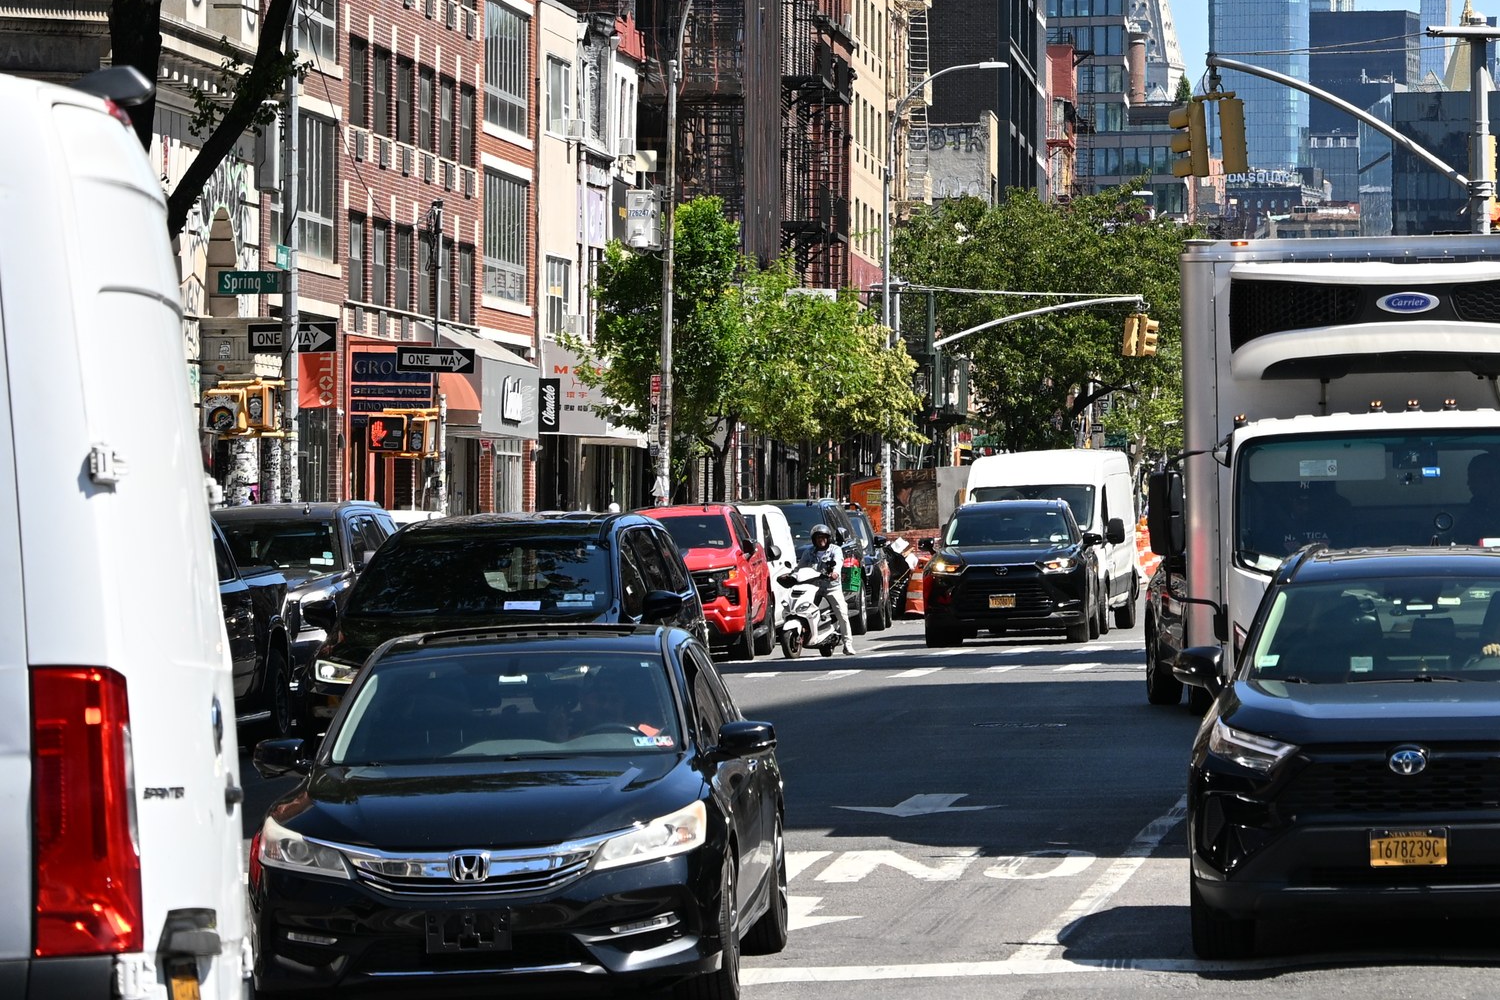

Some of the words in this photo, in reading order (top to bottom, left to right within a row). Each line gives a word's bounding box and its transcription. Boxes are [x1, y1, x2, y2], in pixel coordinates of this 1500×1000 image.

[628, 209, 649, 217] 726247
[223, 273, 261, 294] Spring
[266, 273, 274, 284] St
[1391, 298, 1425, 307] Carrier
[257, 333, 281, 345] ONE
[408, 354, 430, 365] ONE
[440, 355, 463, 367] WAY
[353, 387, 385, 395] SEIZE
[1284, 531, 1329, 542] NTICA
[1377, 839, 1440, 859] T678239C
